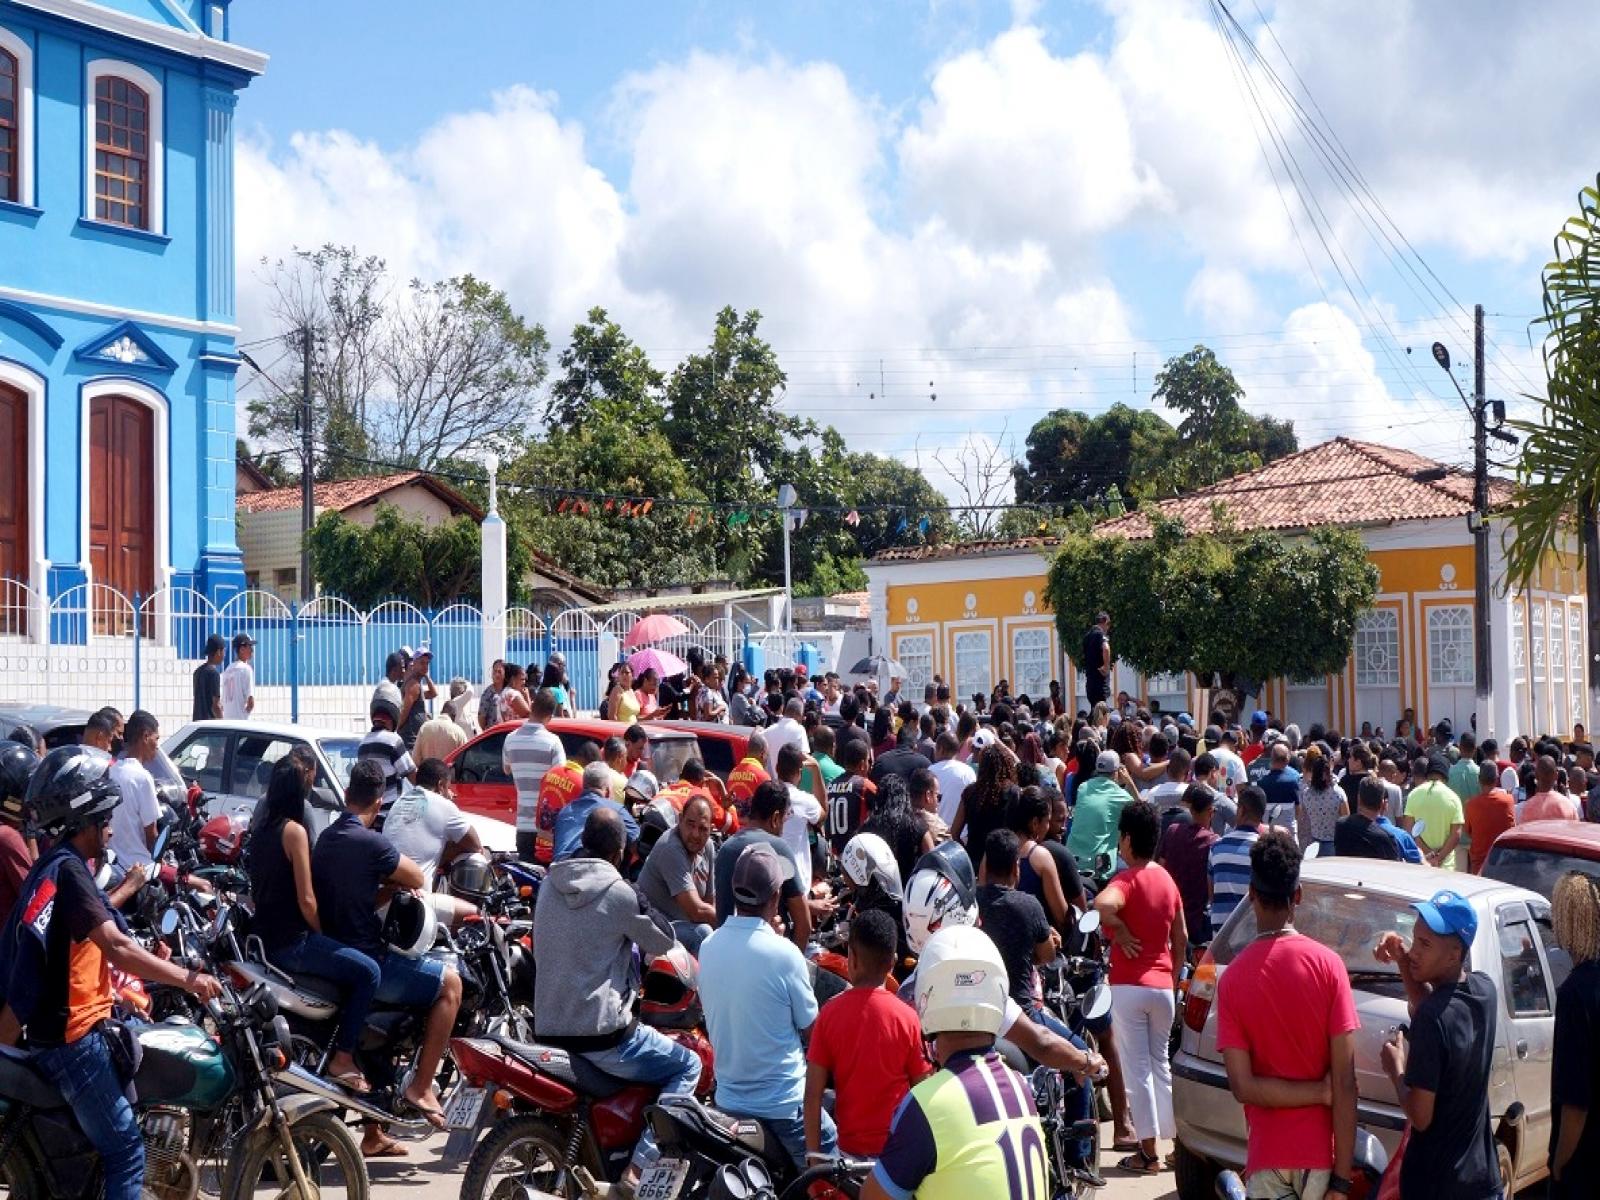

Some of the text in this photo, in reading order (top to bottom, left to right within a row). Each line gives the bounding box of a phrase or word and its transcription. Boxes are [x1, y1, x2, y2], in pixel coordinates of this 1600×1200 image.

[824, 782, 853, 793] CAIXA
[828, 797, 849, 835] 10
[995, 1125, 1049, 1200] 10
